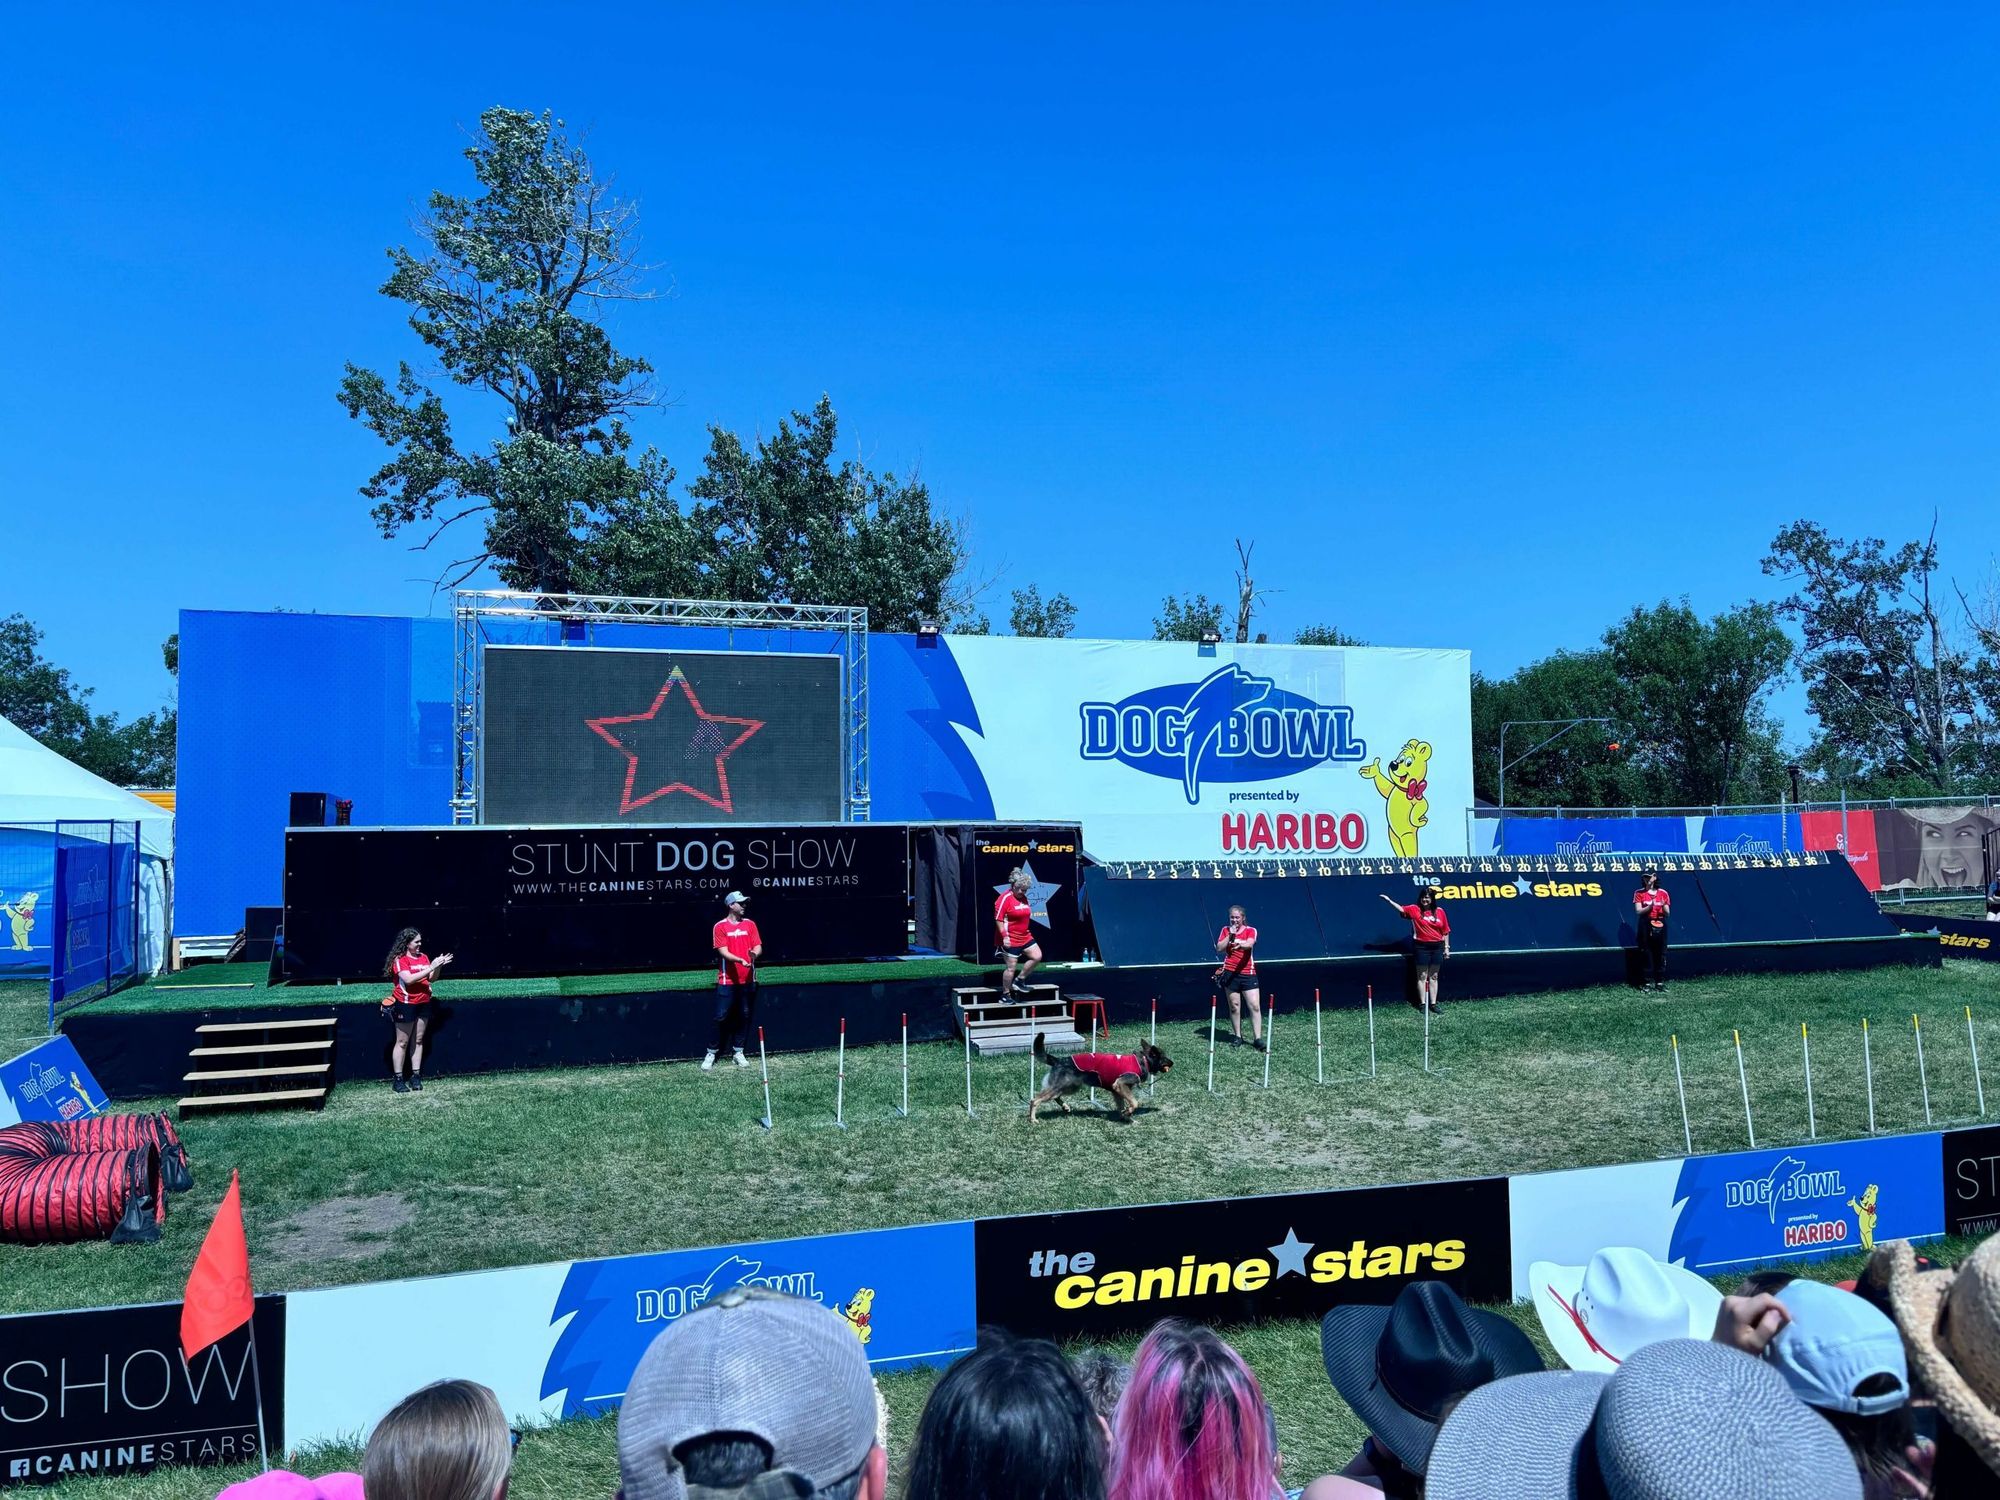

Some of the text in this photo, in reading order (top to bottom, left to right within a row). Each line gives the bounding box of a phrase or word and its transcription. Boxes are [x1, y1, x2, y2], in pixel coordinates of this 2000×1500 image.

[1081, 703, 1365, 759] DOG BOWL
[1229, 790, 1300, 803] presented by
[1221, 812, 1366, 852] HARIBO
[512, 838, 856, 876] STUNT DOG SHOW
[982, 843, 1074, 853] canine stars
[1715, 840, 1774, 854] DOG BOWL
[1126, 868, 1132, 879] 1
[1147, 868, 1156, 879] 2
[1170, 868, 1178, 879] 3
[1191, 868, 1200, 879] 4
[1213, 868, 1222, 879] 5
[1235, 868, 1243, 878] 6
[1256, 868, 1264, 878] 7
[1277, 867, 1286, 878] 8
[1298, 867, 1307, 877] 9
[1317, 867, 1331, 877] 10
[1338, 866, 1350, 876] 11
[1359, 866, 1373, 875] 12
[1379, 865, 1393, 875] 13
[1400, 865, 1413, 874] 14
[1420, 864, 1434, 874] 15
[1440, 864, 1454, 873] 16
[1459, 864, 1472, 873] 17
[1479, 863, 1493, 873] 18
[1498, 863, 1512, 873] 19
[1517, 863, 1531, 872] 20
[1536, 863, 1549, 872] 21
[1555, 863, 1569, 872] 22
[1574, 863, 1587, 872] 23
[1592, 863, 1605, 872] 24
[1610, 862, 1624, 872] 25
[1628, 862, 1641, 872] 26
[1663, 862, 1677, 871] 28
[1681, 862, 1695, 871] 29
[1699, 862, 1712, 870] 30
[1716, 861, 1729, 870] 31
[1734, 861, 1748, 869] 32
[1751, 860, 1765, 869] 33
[1770, 860, 1783, 868] 34
[1787, 858, 1800, 867] 35
[1804, 857, 1817, 866] 36
[513, 875, 859, 895] WWW.THECANINESTARS.COM @CANINESTARS
[1412, 875, 1441, 886] the
[1534, 880, 1602, 898] stars
[1940, 933, 1991, 949] stars
[19, 1078, 44, 1103] DOG
[1726, 1170, 1846, 1208] DOG BOWL
[1788, 1213, 1819, 1223] presented by
[1785, 1220, 1847, 1247] HARIBO
[1029, 1250, 1096, 1277] the
[1053, 1239, 1467, 1310] canine stars
[0, 1340, 253, 1424] SHOW
